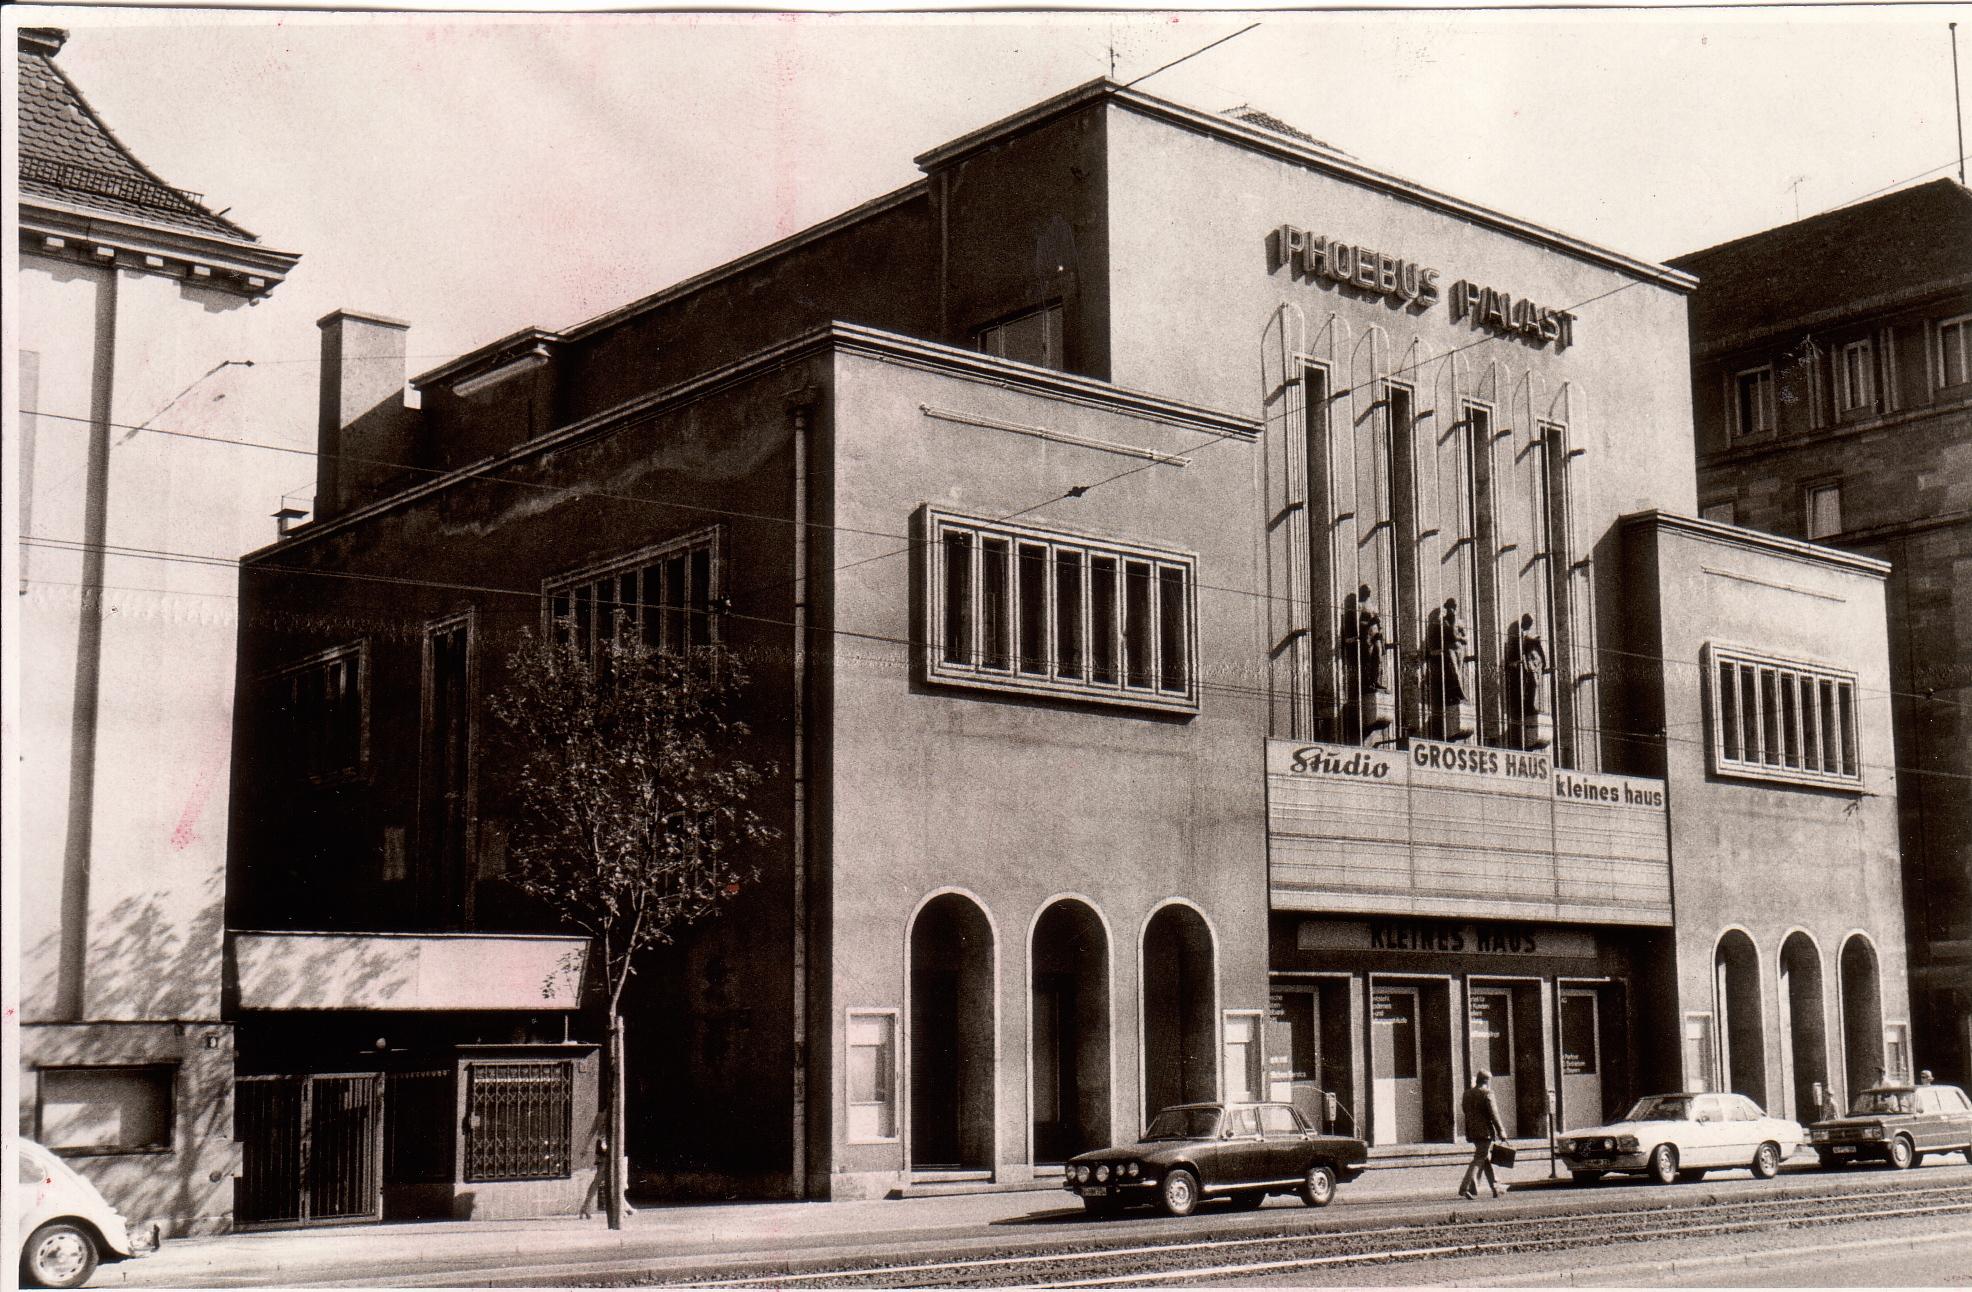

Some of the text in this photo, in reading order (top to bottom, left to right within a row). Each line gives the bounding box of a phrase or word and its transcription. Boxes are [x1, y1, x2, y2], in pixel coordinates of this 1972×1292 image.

[1277, 224, 1577, 346] PHOEBUS PALAST
[1290, 747, 1390, 777] Studio
[1414, 744, 1547, 779] GROSSES HAUS
[1556, 774, 1662, 806] kleines haus
[1371, 920, 1537, 953] KLEINES HAUS
